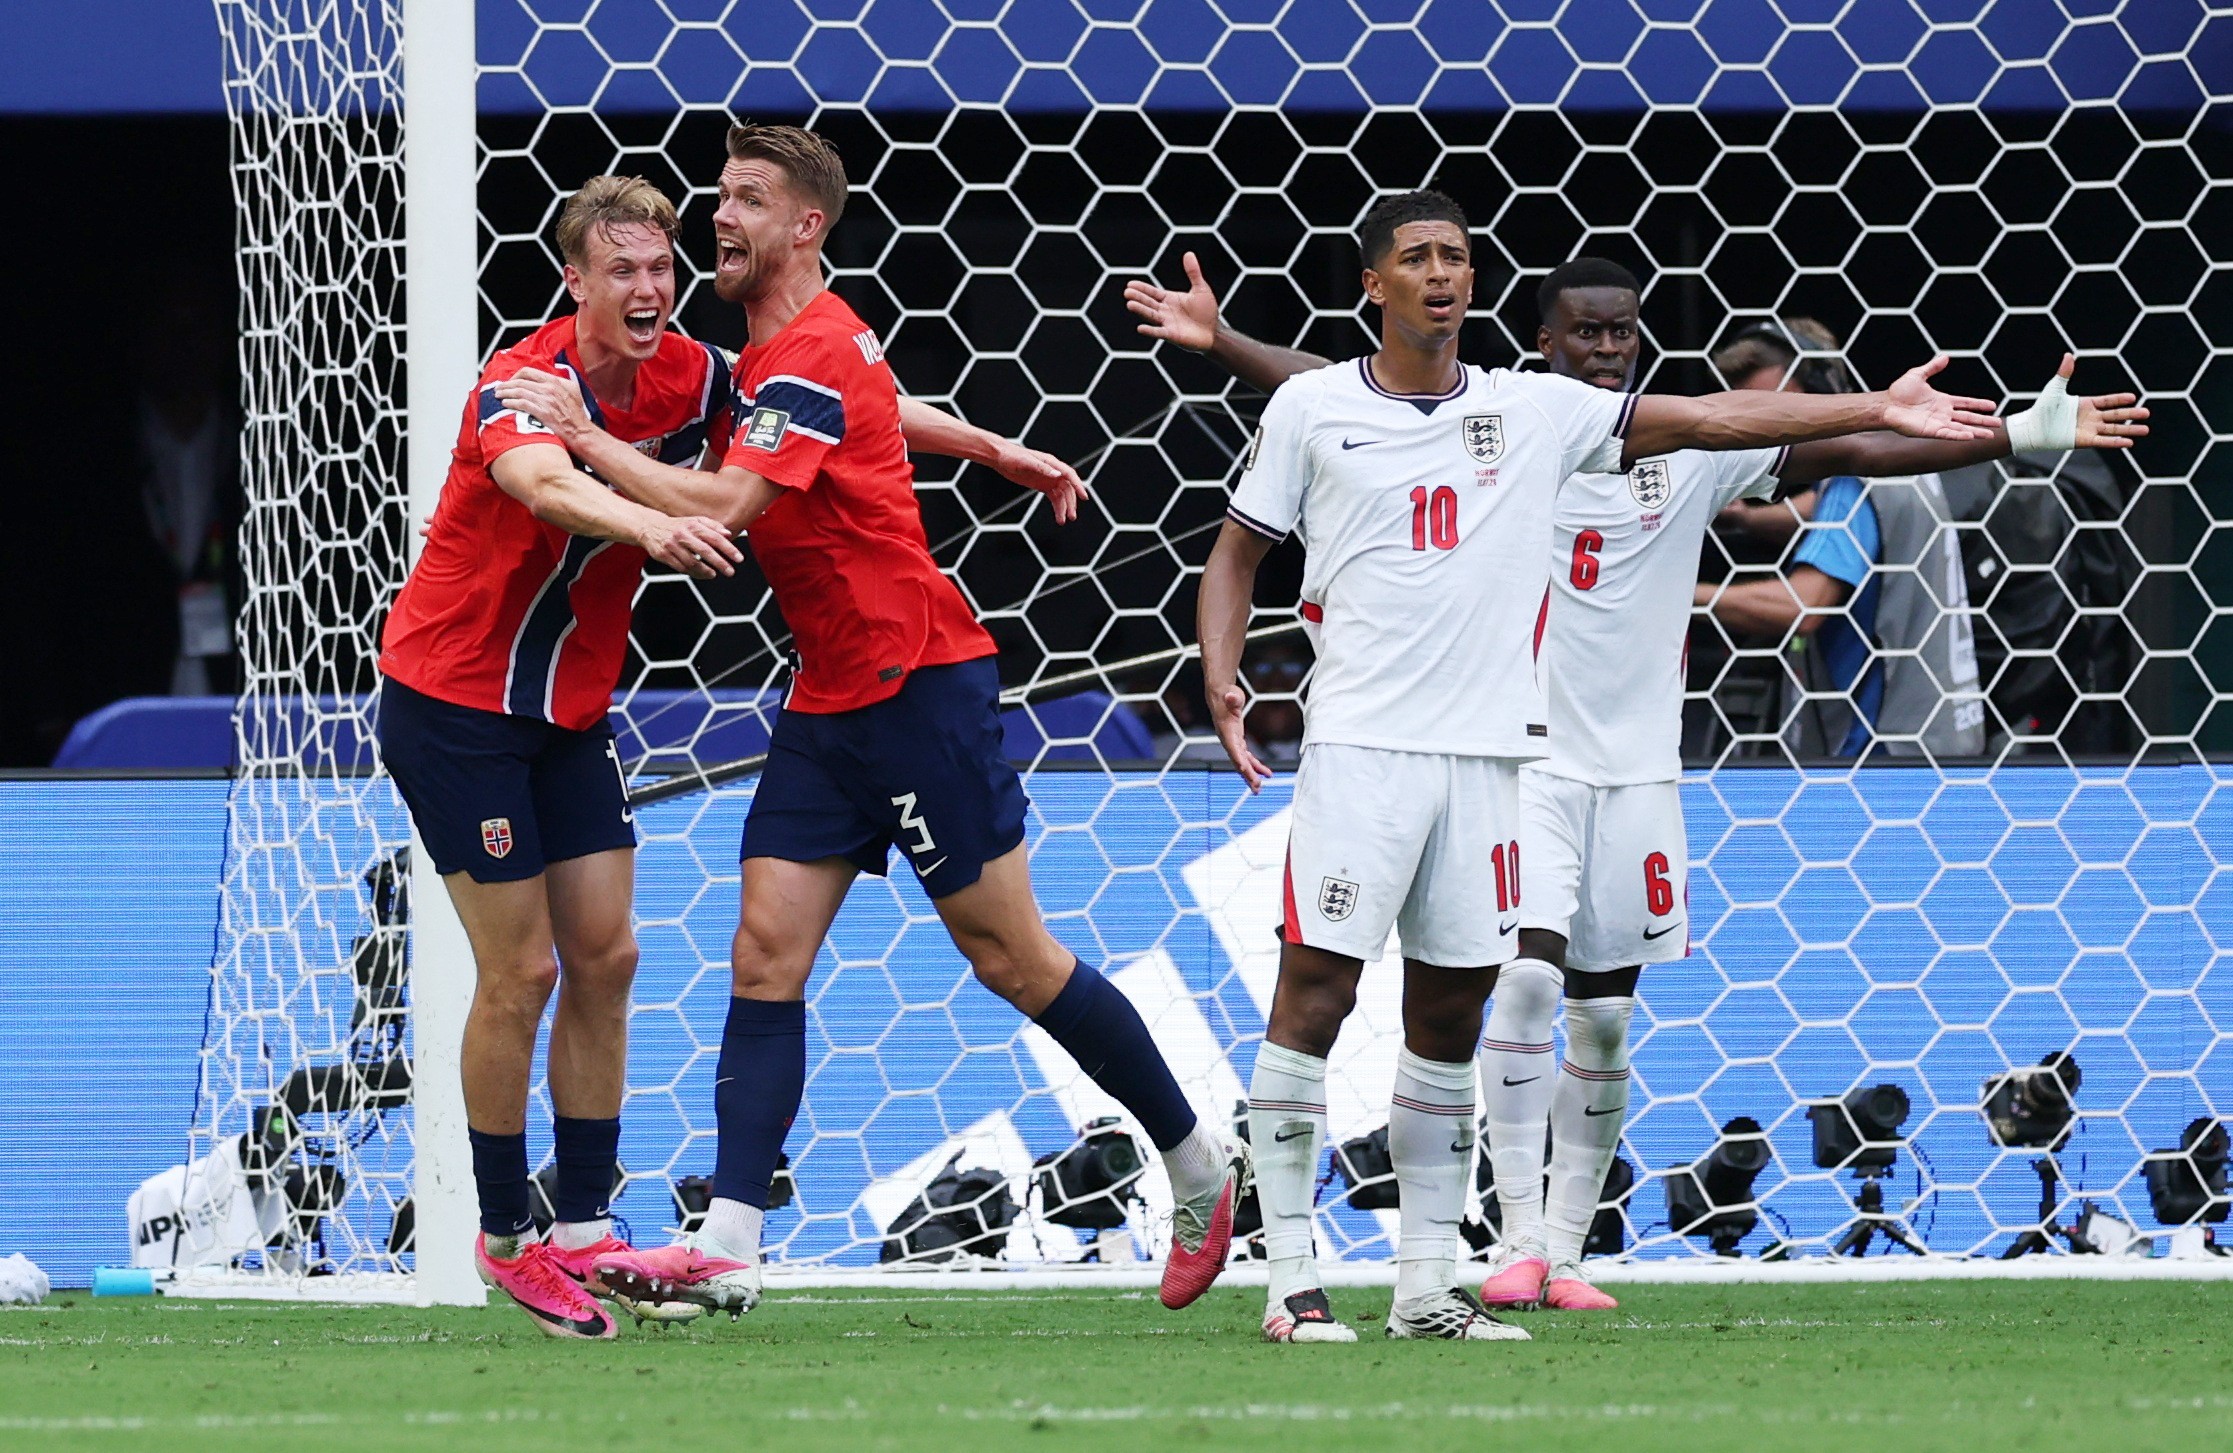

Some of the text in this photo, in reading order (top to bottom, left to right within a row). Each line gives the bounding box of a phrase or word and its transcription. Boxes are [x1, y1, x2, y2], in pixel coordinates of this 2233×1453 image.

[1410, 486, 1459, 550] 10
[1570, 529, 1604, 590] 6
[891, 792, 936, 854] 3
[1491, 840, 1521, 912] 10
[1643, 851, 1674, 917] 6
